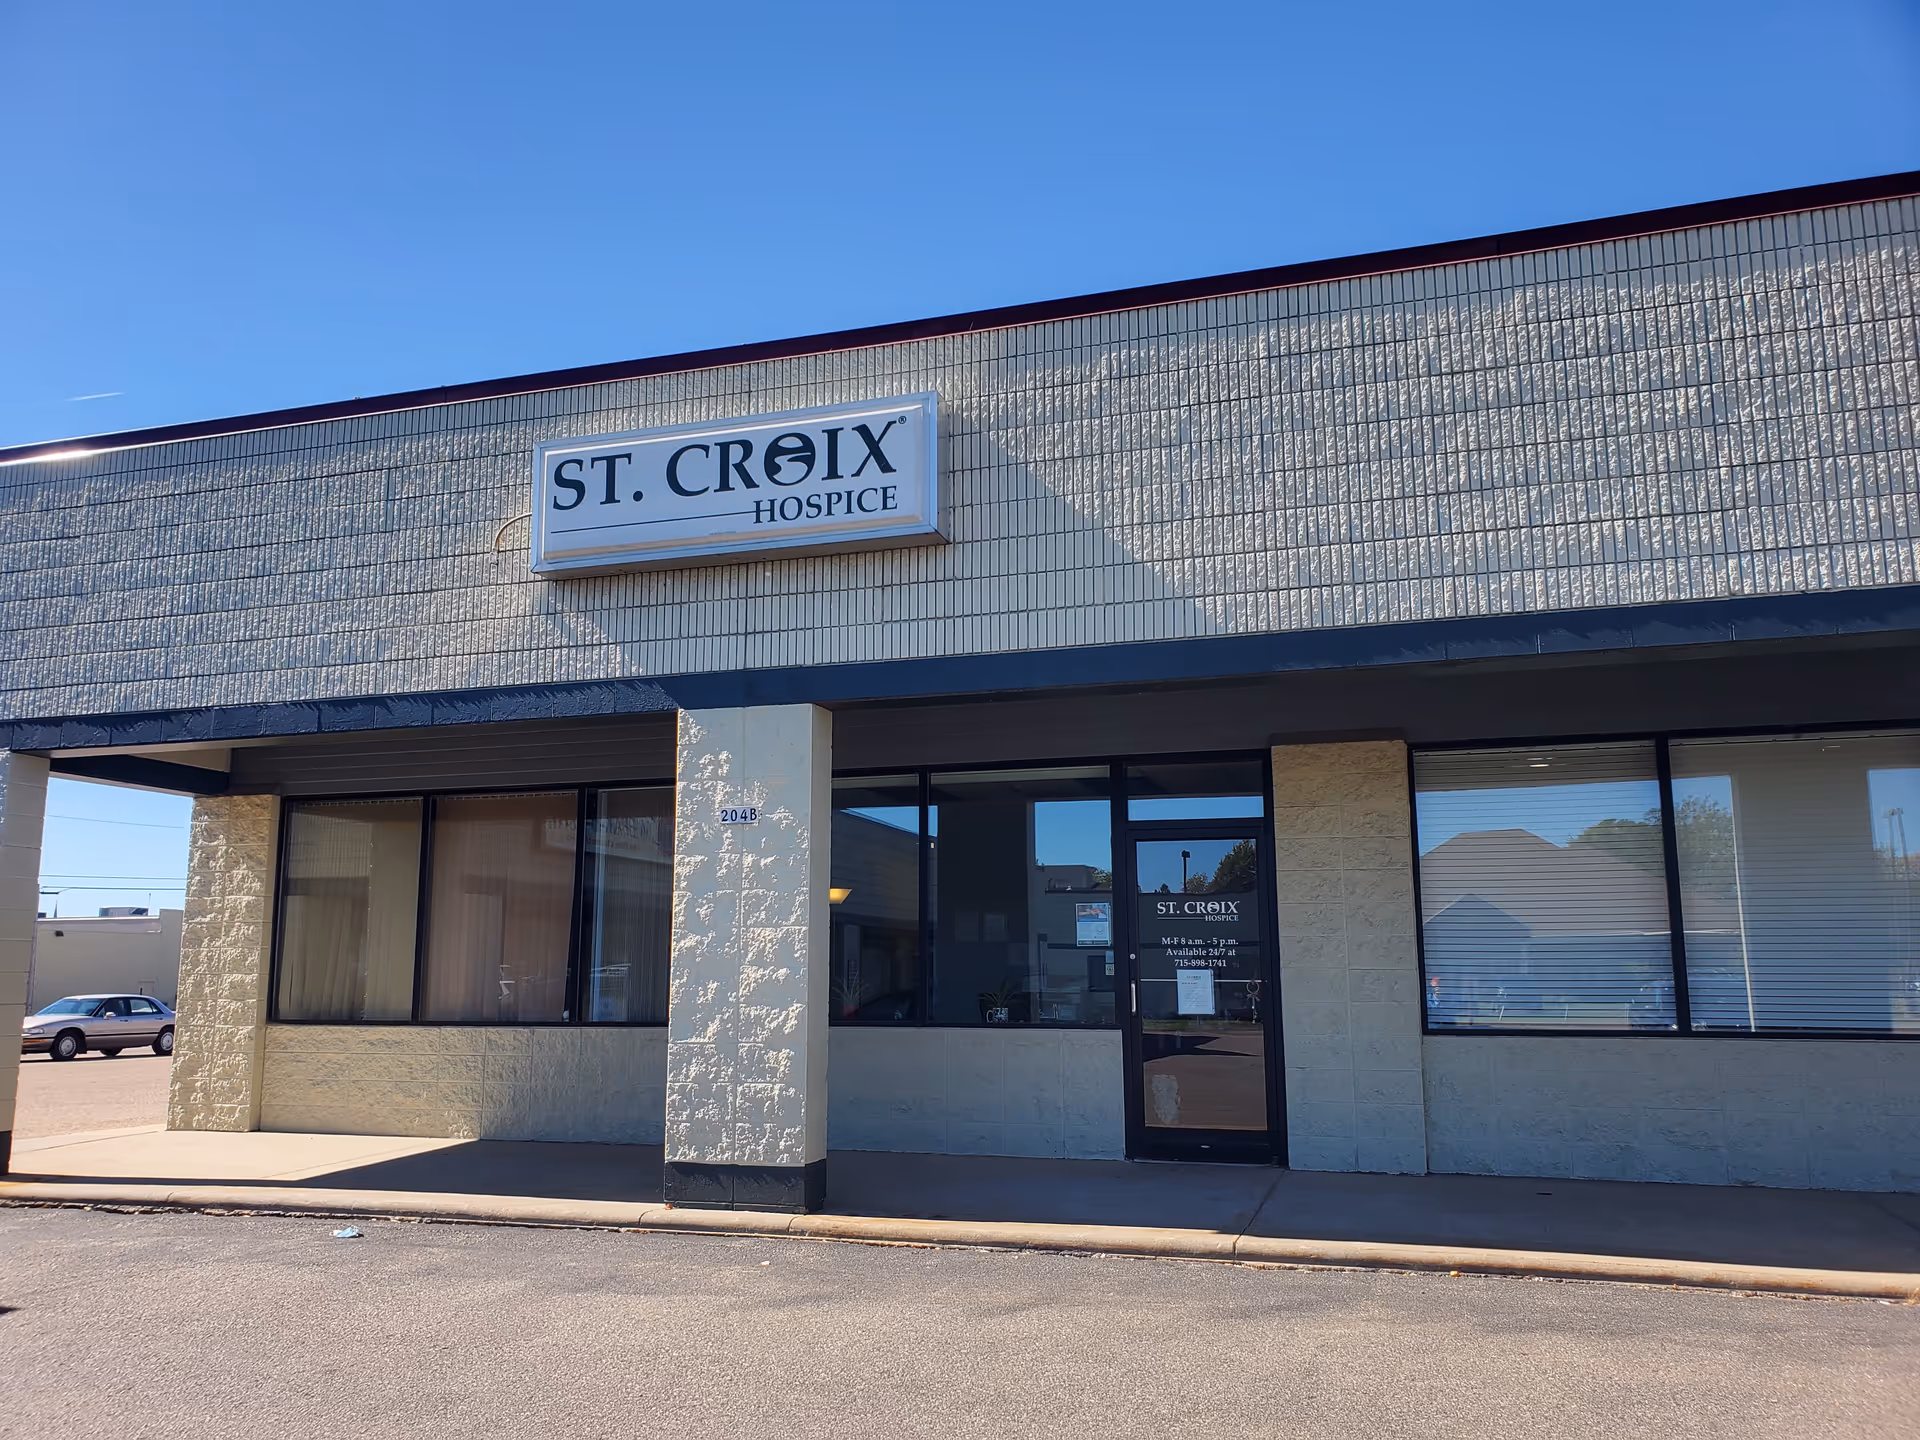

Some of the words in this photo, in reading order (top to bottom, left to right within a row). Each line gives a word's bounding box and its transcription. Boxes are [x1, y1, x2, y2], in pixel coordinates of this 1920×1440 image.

[553, 452, 644, 511] ST.
[753, 485, 898, 524] HOSPICE
[721, 808, 758, 822] 204B
[1157, 901, 1180, 914] ST.
[1161, 937, 1179, 945] M-F
[1180, 937, 1186, 945] 8
[1212, 937, 1218, 945] 5
[1219, 939, 1239, 947] p.m.
[1166, 947, 1207, 956] Available
[1208, 948, 1226, 956] 24/7
[1227, 948, 1236, 956] at
[1174, 959, 1227, 967] 715-898-1741
